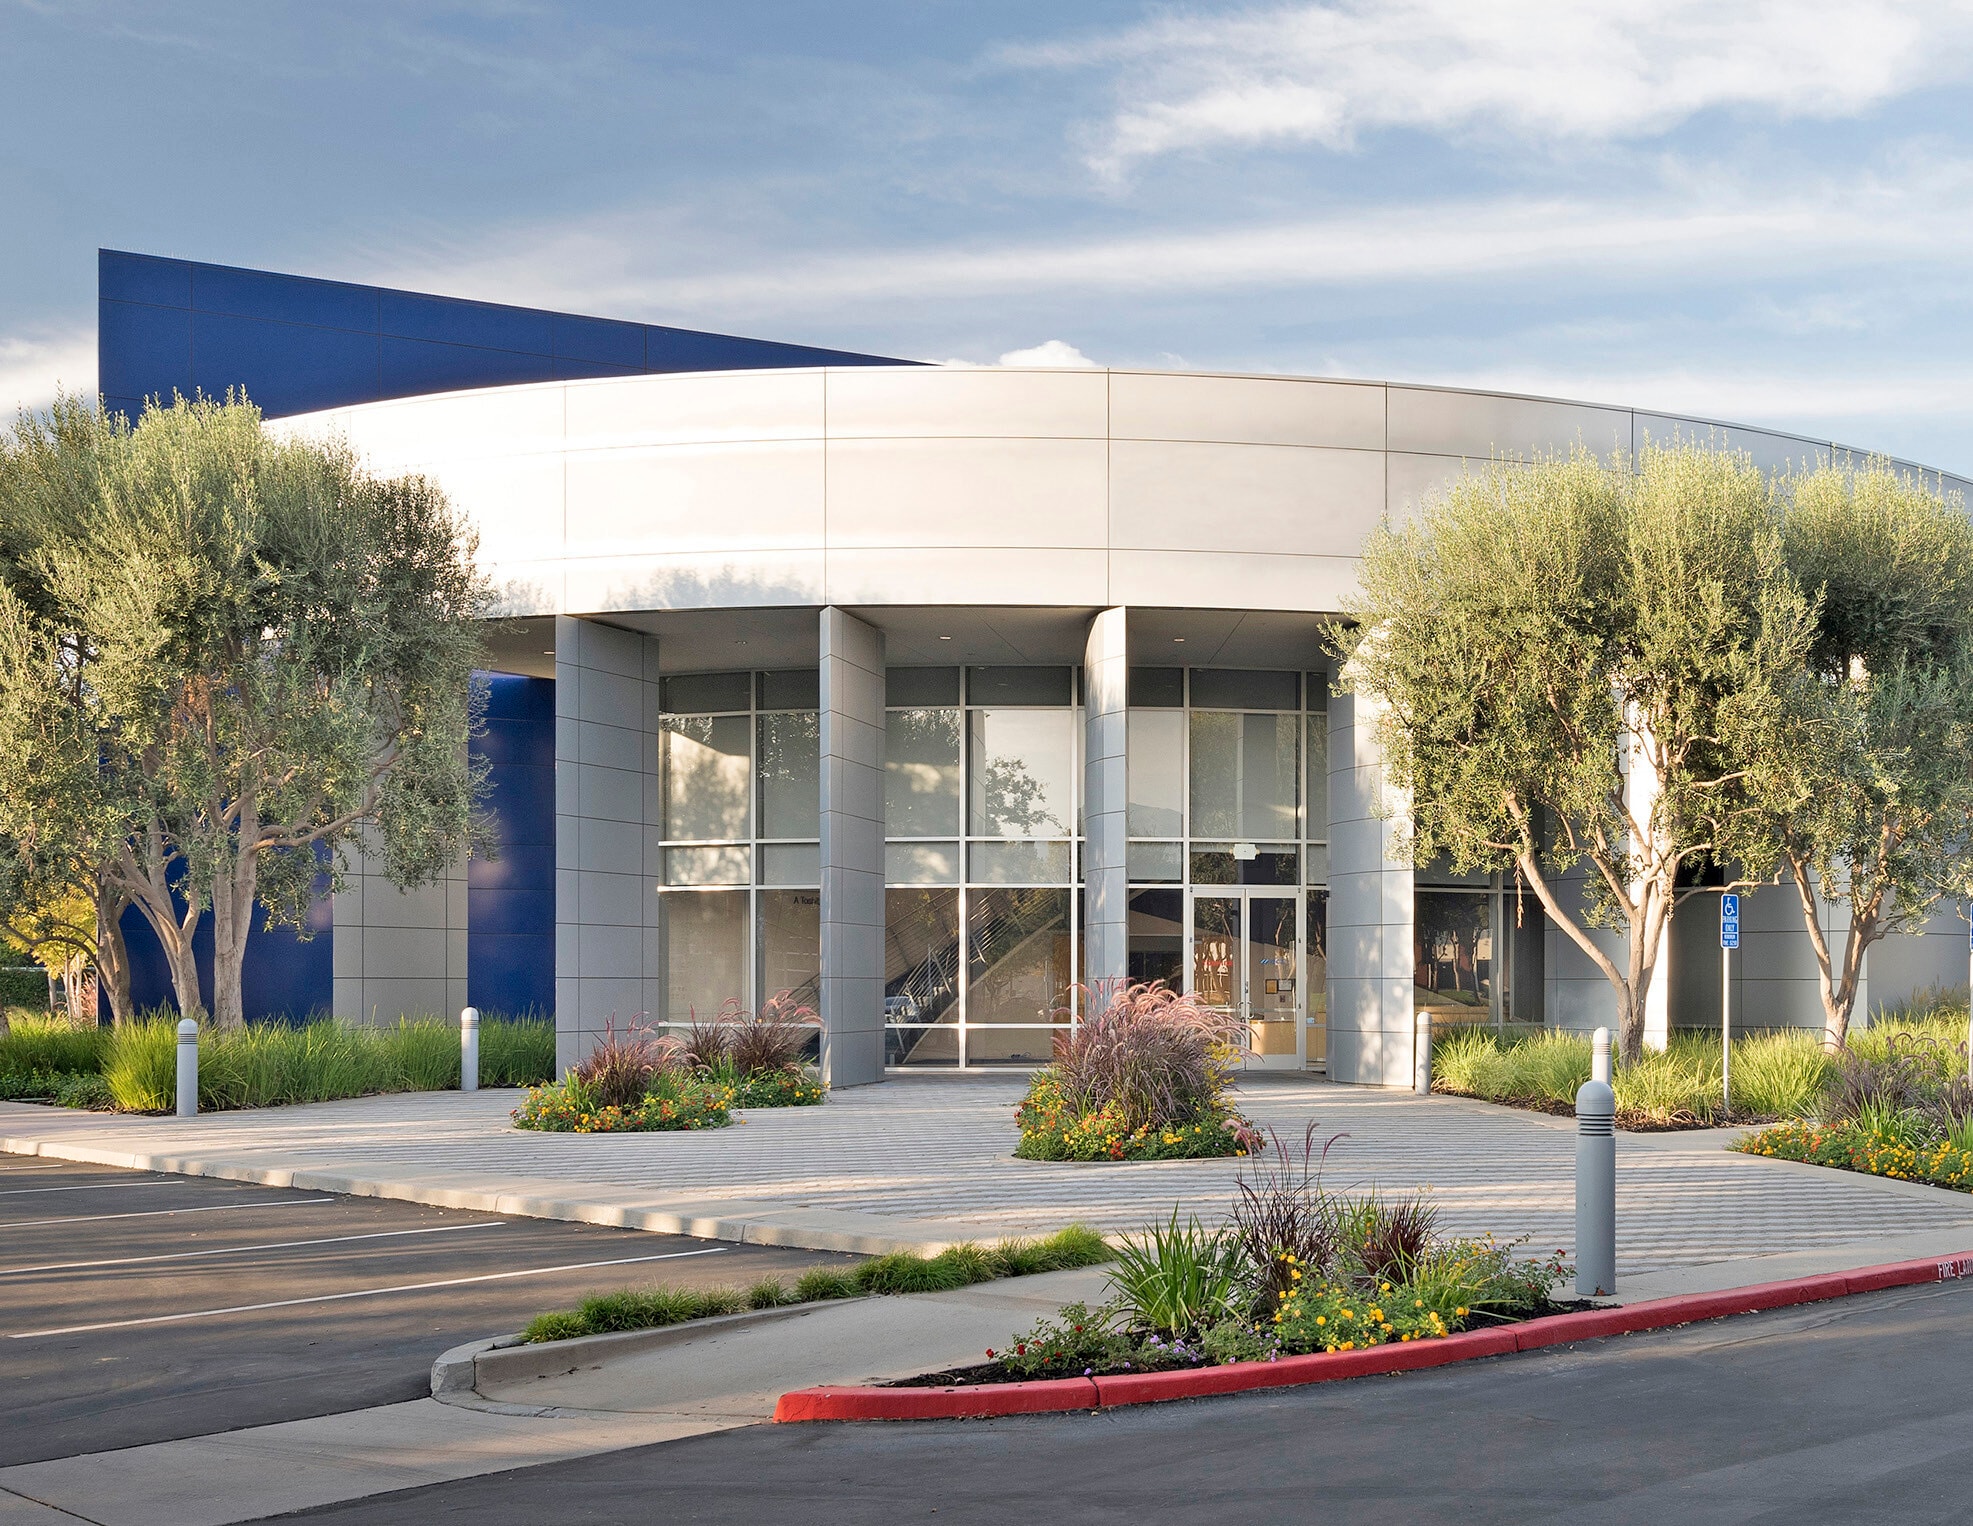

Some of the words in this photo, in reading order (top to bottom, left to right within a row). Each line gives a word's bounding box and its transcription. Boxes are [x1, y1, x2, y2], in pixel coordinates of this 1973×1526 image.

[793, 896, 799, 904] A
[1937, 1261, 1956, 1278] FIRE
[1956, 1258, 1973, 1276] LAN
